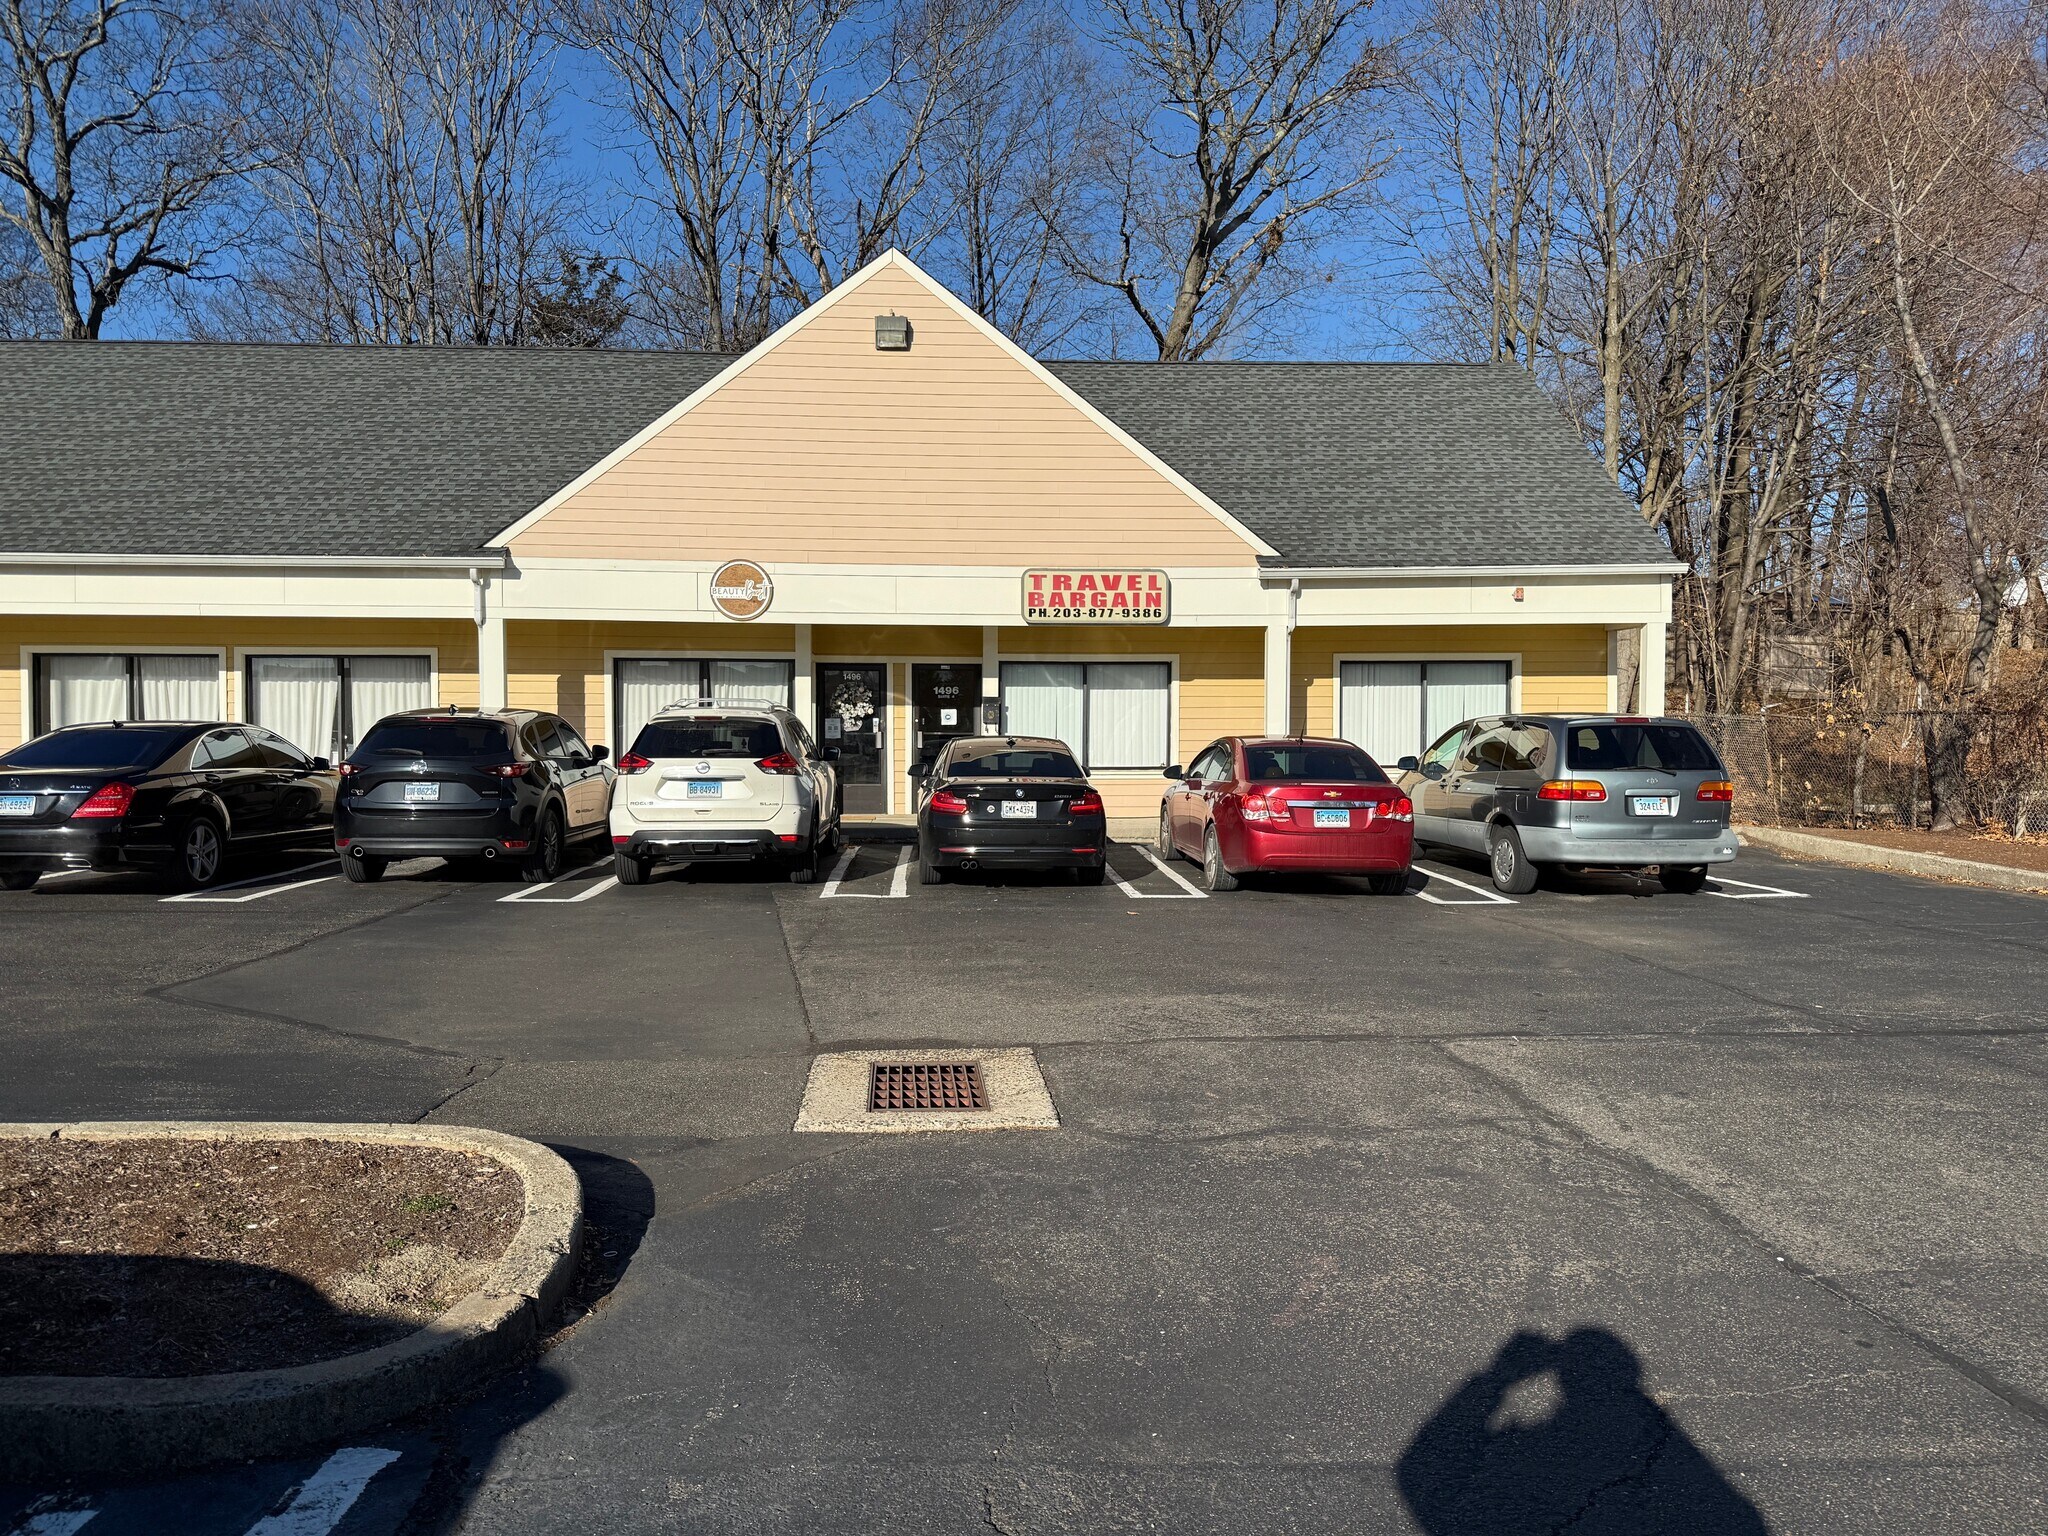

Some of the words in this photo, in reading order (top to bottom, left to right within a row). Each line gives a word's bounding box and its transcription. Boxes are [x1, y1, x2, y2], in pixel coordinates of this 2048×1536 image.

[1028, 574, 1162, 591] TRAVEL
[712, 587, 745, 595] BEAUTY
[1028, 592, 1162, 607] BARGAIN
[933, 686, 959, 695] 1496
